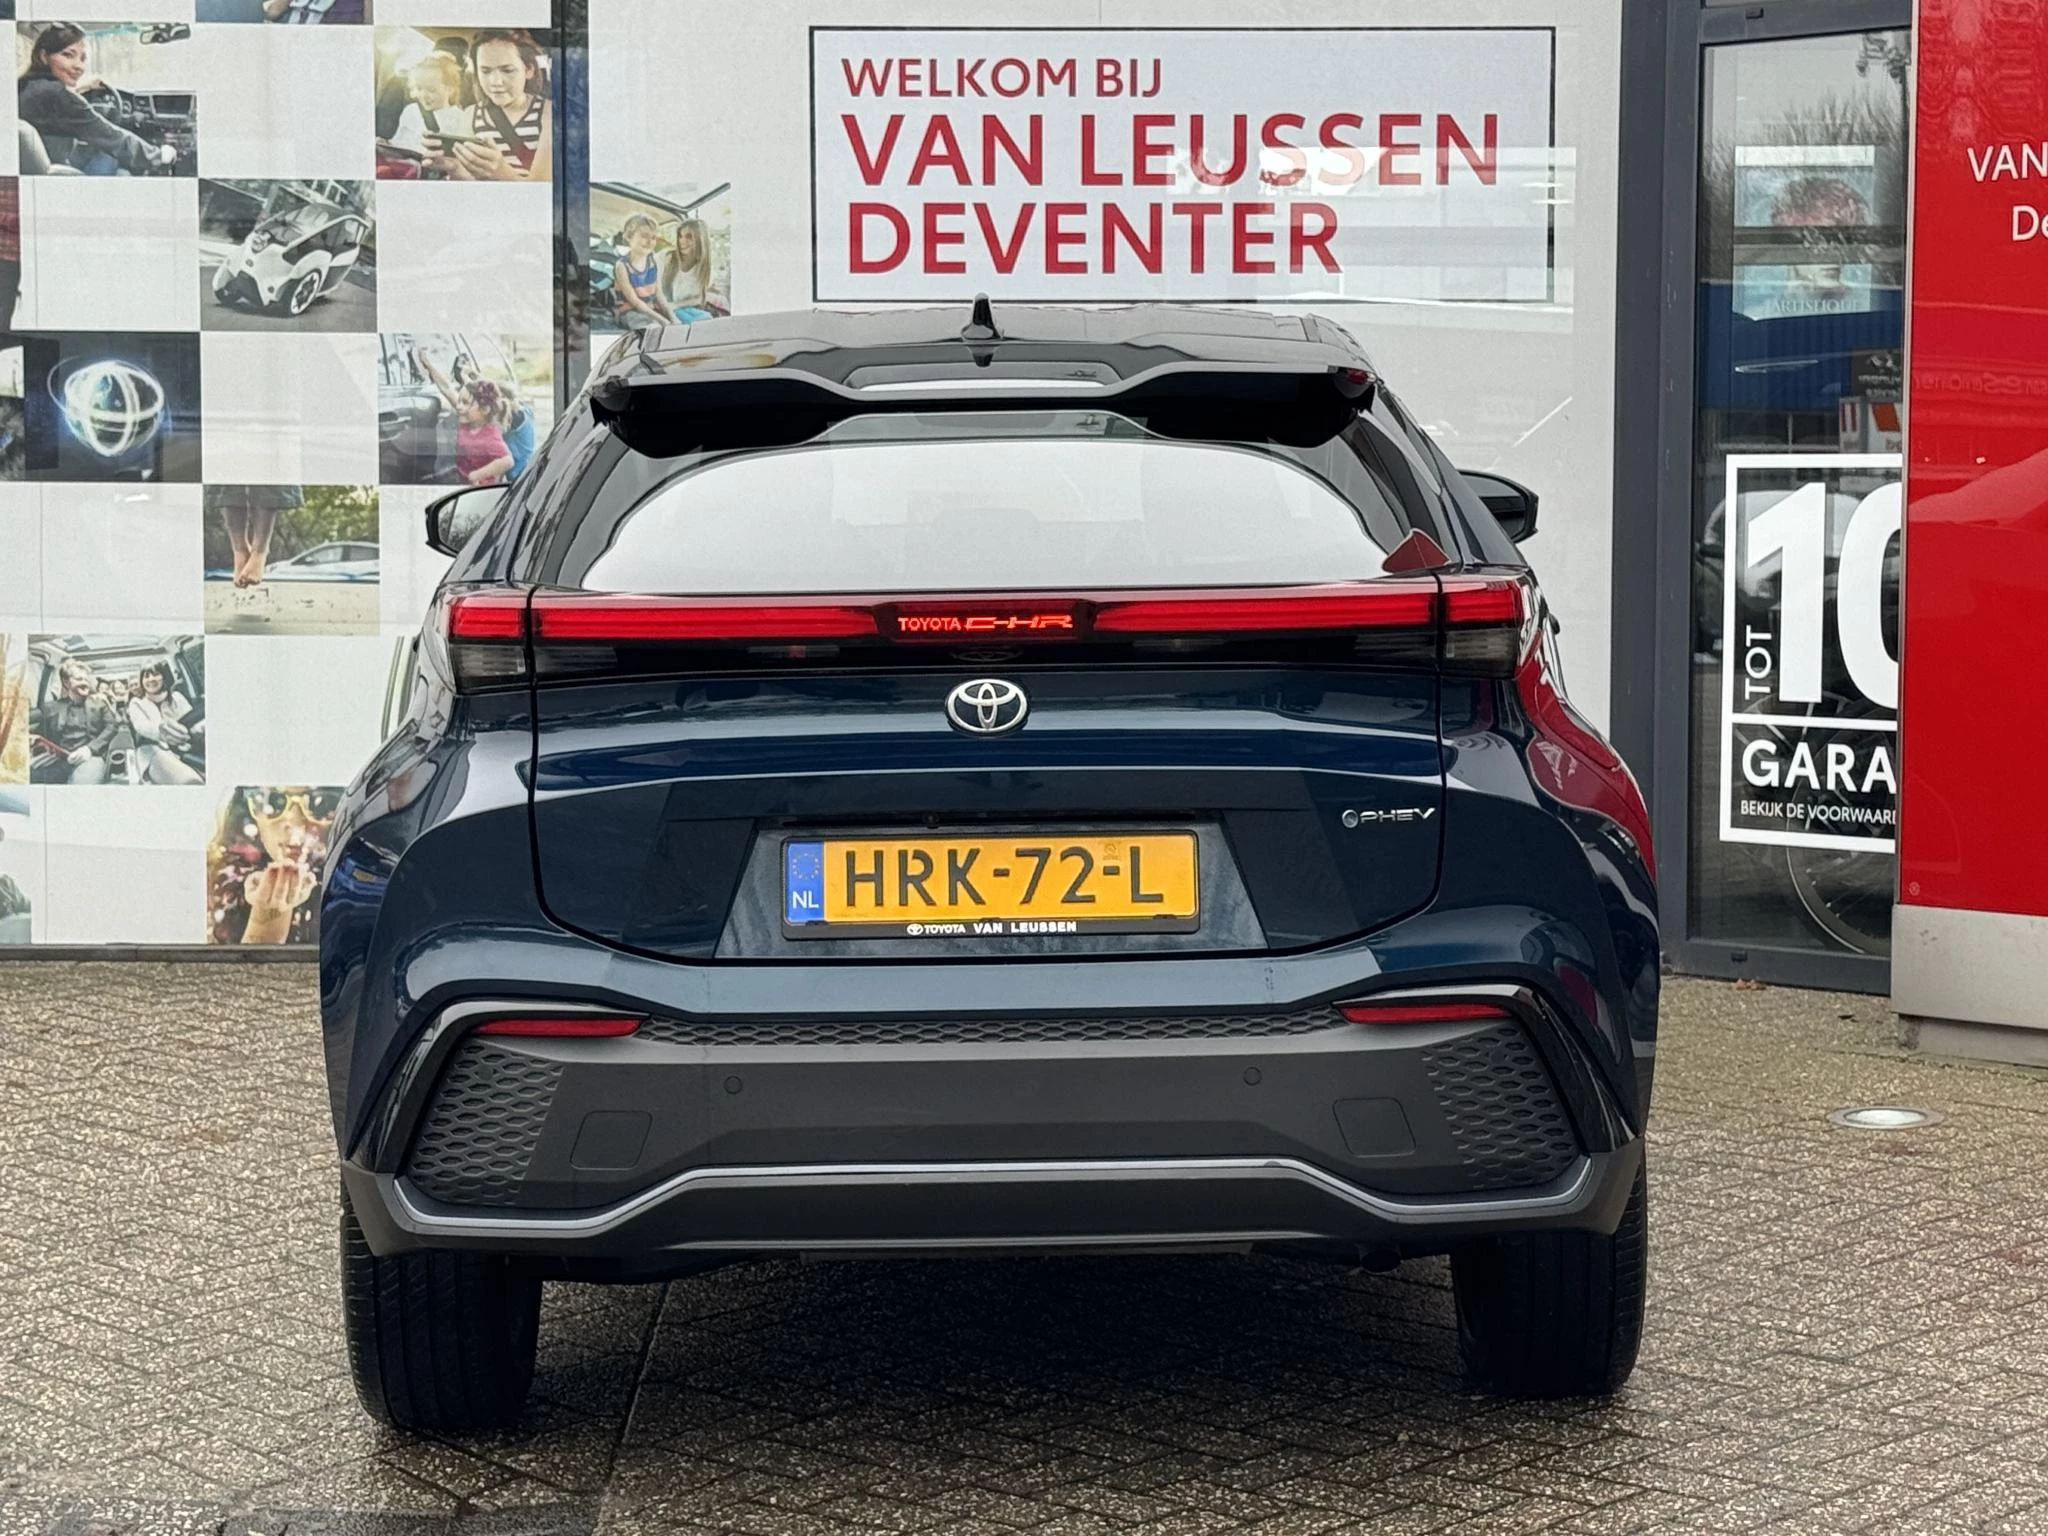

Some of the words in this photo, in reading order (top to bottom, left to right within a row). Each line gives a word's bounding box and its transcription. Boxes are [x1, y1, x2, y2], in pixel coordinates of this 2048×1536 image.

[841, 58, 1076, 98] WELKOM
[1095, 58, 1162, 98] BIJ
[841, 113, 1043, 186] VAN
[1080, 112, 1498, 187] LEUSSEN
[1966, 141, 2048, 182] VAN
[848, 201, 1343, 275] DEVENTER
[898, 616, 962, 632] TOYOTA
[965, 615, 1073, 630] C-HR
[1744, 624, 1772, 701] TOT
[1741, 738, 1897, 796] GARA
[1359, 807, 1436, 824] PHEV
[1740, 799, 1784, 818] BEKIJK
[1786, 803, 1805, 819] DE
[845, 845, 1164, 907] HRK-72-L
[791, 891, 820, 909] NL
[923, 923, 967, 935] TOYOTA
[973, 922, 1003, 934] VAN
[1010, 921, 1077, 934] LEUSSEN
